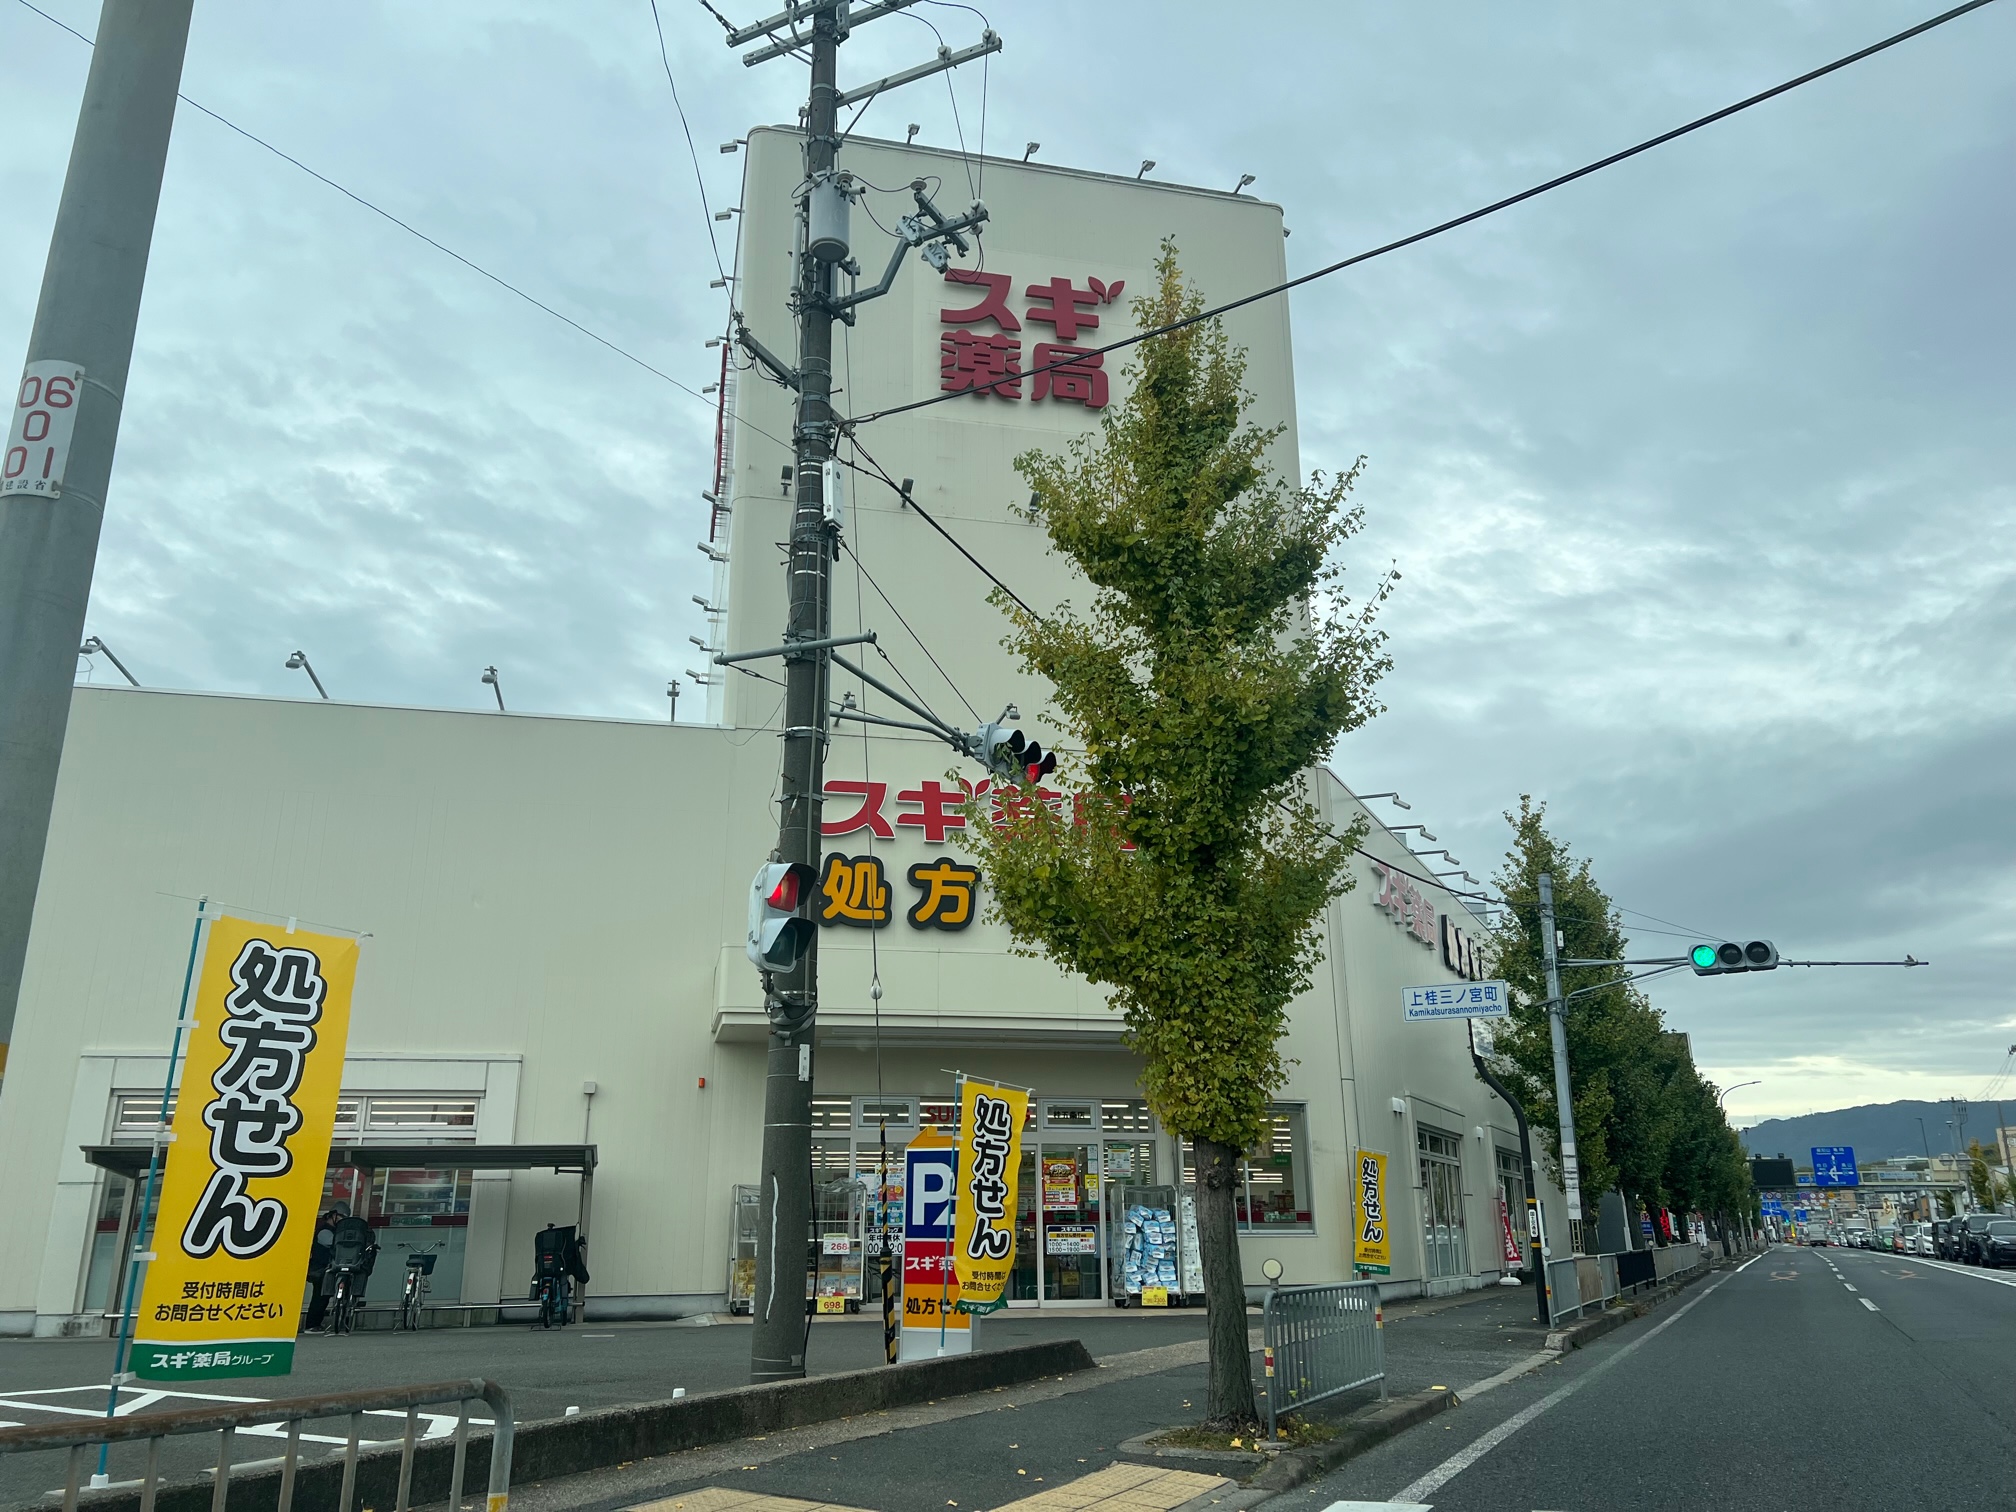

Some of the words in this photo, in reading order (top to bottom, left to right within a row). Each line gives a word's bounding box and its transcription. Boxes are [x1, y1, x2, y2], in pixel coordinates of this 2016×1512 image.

[941, 268, 1125, 341] スギ
[941, 329, 1109, 408] 薬局
[19, 376, 75, 408] 06
[23, 410, 50, 441] 0
[1409, 1004, 1502, 1017] Kamikatsurasannomiyacho
[1411, 986, 1497, 1006] 上桂三ノ宮町
[181, 938, 327, 1260] 処方せん
[968, 1093, 1012, 1259] 処方せん
[913, 1163, 955, 1225] P
[1361, 1156, 1384, 1243] 処方せん
[181, 1281, 266, 1299] 受付時間は
[155, 1302, 283, 1321] お問合せください
[150, 1351, 274, 1369] スギ薬局グループ
